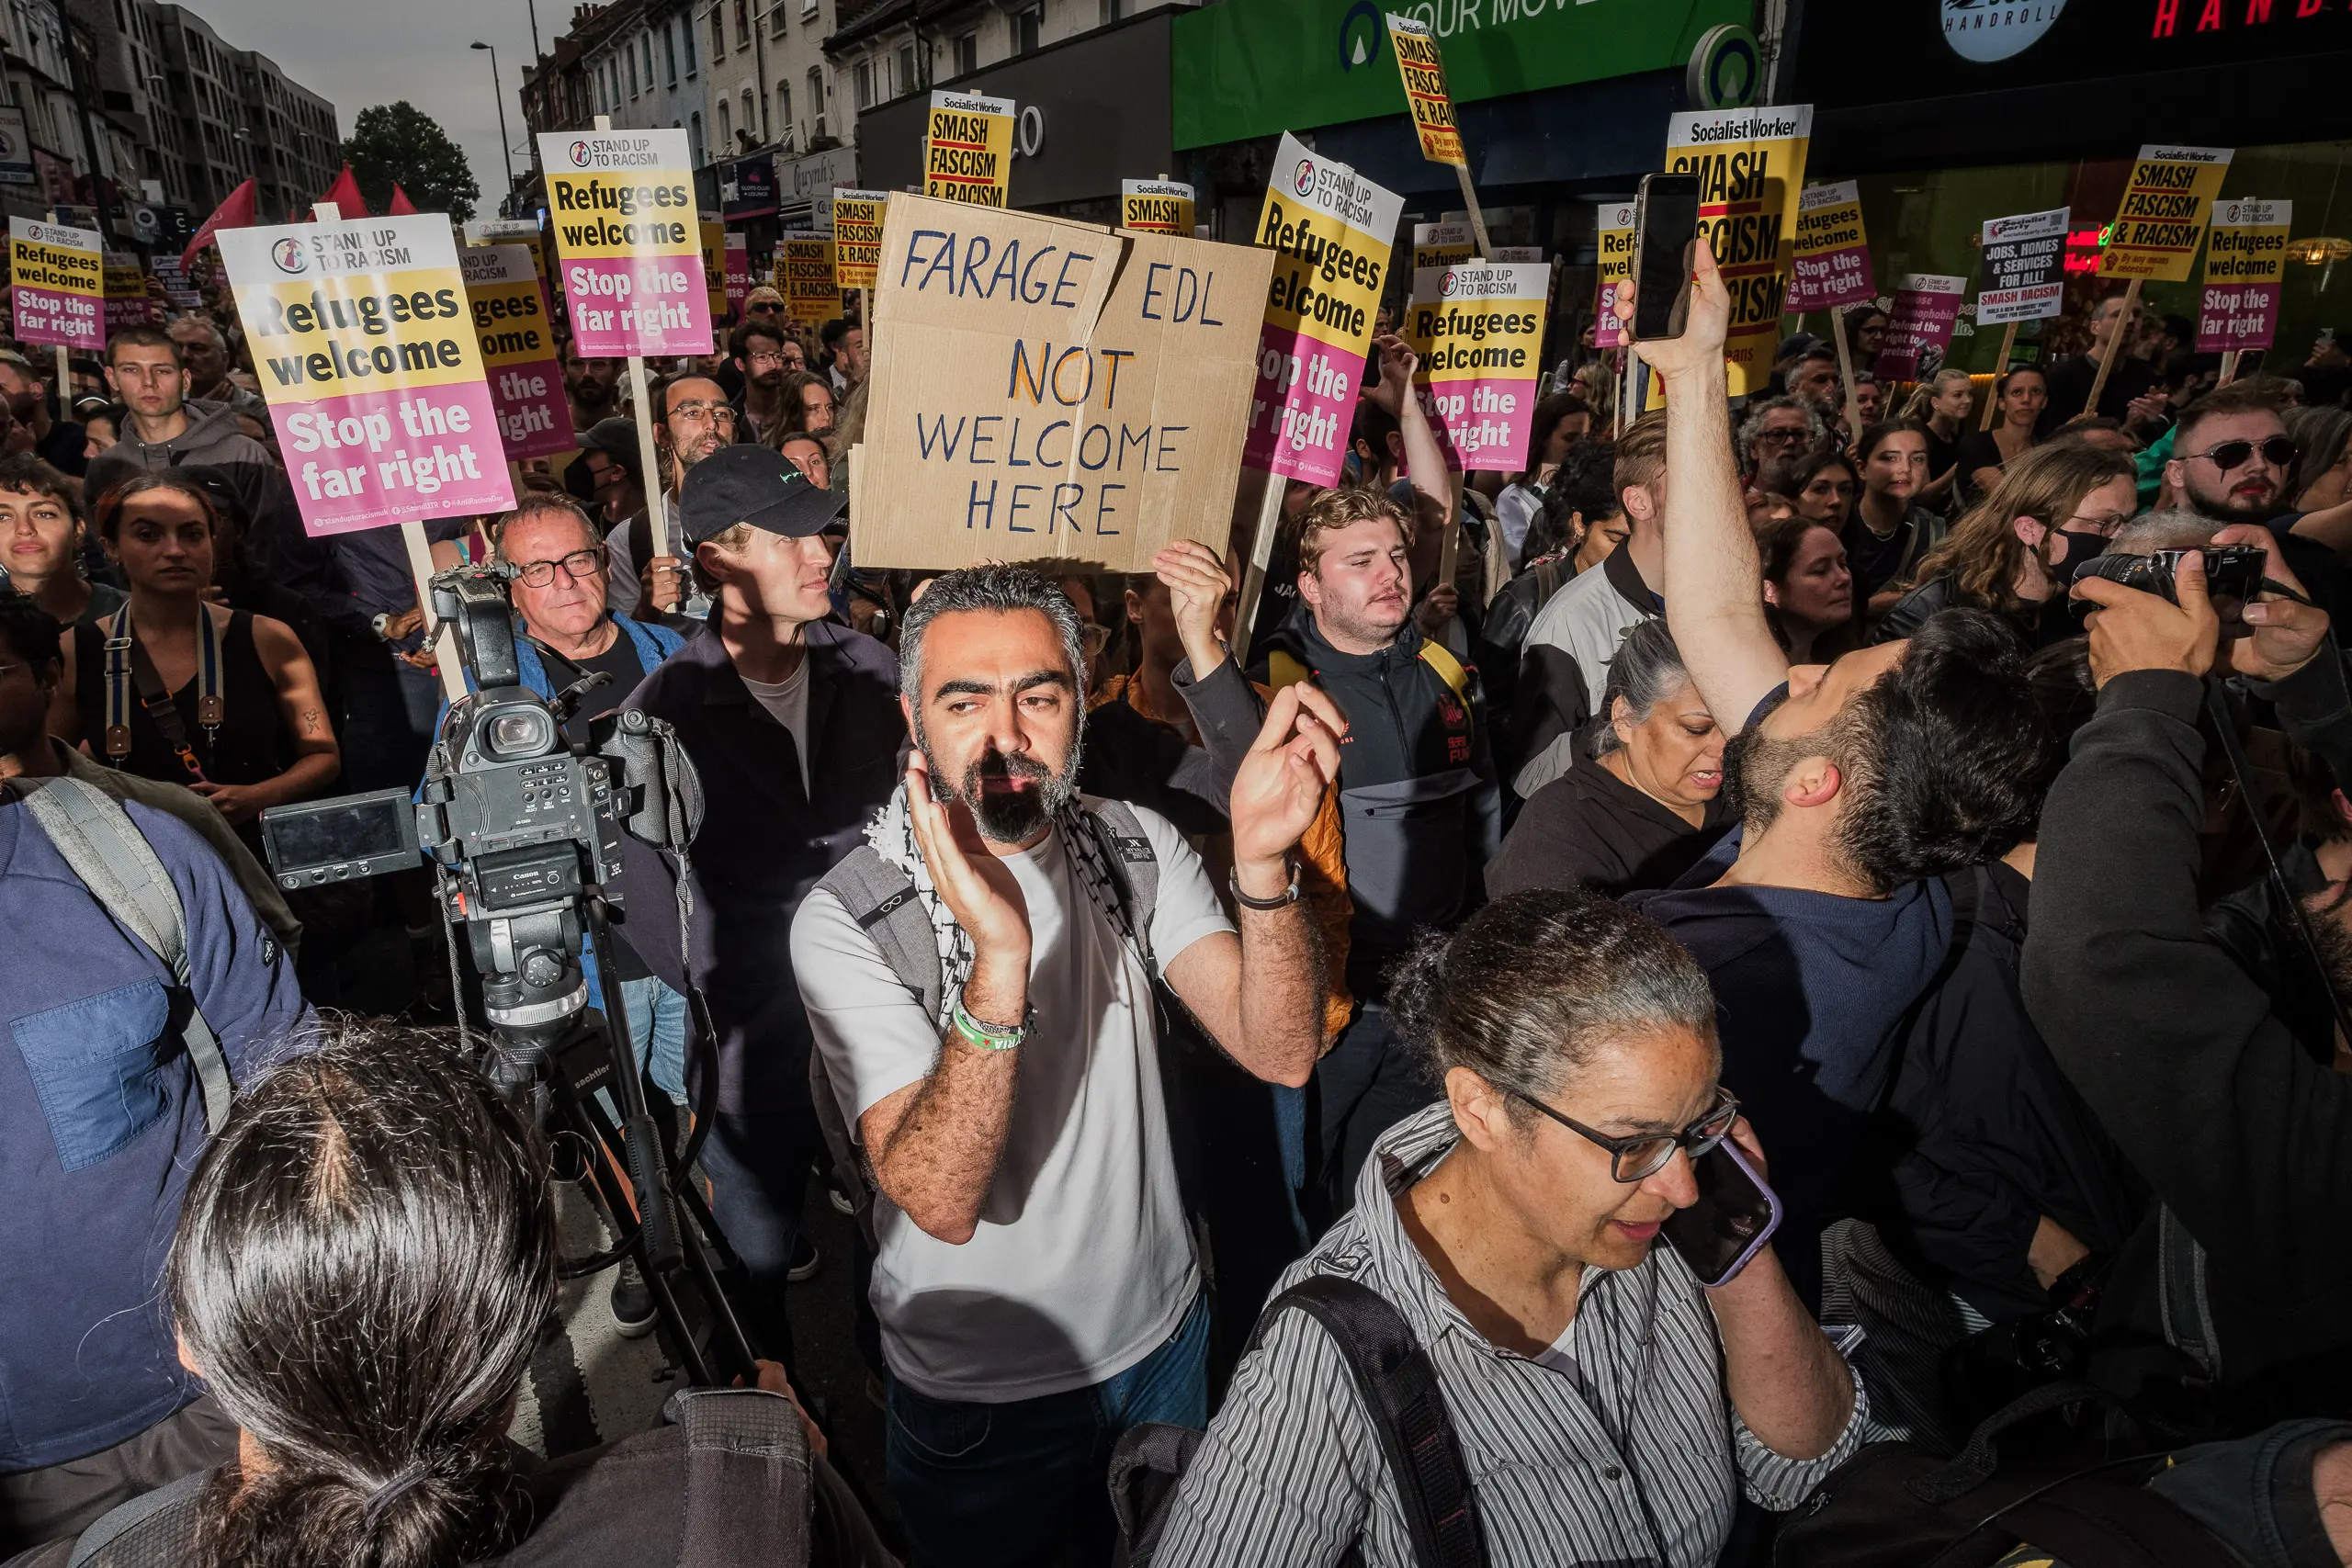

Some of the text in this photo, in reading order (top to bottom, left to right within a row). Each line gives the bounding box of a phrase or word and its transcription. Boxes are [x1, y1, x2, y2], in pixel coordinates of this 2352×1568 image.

[1943, 5, 2057, 33] HANDROLL
[1396, 35, 1438, 63] SMAS
[1404, 67, 1450, 96] FASCI
[933, 113, 989, 144] SMASH
[593, 139, 650, 154] STAND UP
[594, 152, 658, 167] TO RACISM
[931, 148, 996, 177] FASCISM
[1319, 167, 1372, 203] STAND UP
[2134, 164, 2198, 188] SMASH
[555, 180, 688, 216] Refugees
[929, 181, 1003, 209] & RACISM
[1317, 187, 1373, 228] TO RACISM
[1804, 190, 1826, 200] STAND
[1817, 196, 1842, 206] RACISM
[2123, 194, 2200, 218] FASCISM
[836, 201, 875, 220] SMASH
[1127, 198, 1180, 223] SMASH
[1797, 209, 1859, 231] efugees
[2242, 205, 2272, 213] STAND UP
[2242, 214, 2250, 222] TO
[44, 228, 68, 238] STAND
[56, 237, 84, 247] RACISM
[375, 230, 397, 248] UP
[562, 217, 686, 247] welcome
[837, 223, 884, 243] FASCISM
[1698, 213, 1781, 265] SCISM
[2113, 222, 2129, 243] &
[2132, 223, 2200, 247] RACISM
[2211, 231, 2284, 255] Refugees
[16, 243, 99, 272] Refugees
[346, 247, 412, 269] RACISM
[787, 243, 824, 258] SMASH
[838, 246, 881, 264] & RACIS
[1263, 200, 1382, 292] Refugees
[1986, 239, 2059, 260] JOBS, HOMES
[482, 254, 498, 266] UP
[788, 263, 832, 277] FASCISM
[1418, 251, 1472, 268] Refugees
[1796, 254, 1860, 277] Stop the
[1993, 263, 2001, 275] &
[2004, 254, 2052, 273] SERVICES
[2210, 256, 2277, 276] welcome
[17, 267, 96, 290] welcome
[465, 266, 508, 282] RACISM
[571, 265, 689, 302] Stop the
[900, 230, 1224, 327] FARAGE EDL
[1461, 270, 1512, 282] STAND UP
[1801, 272, 1864, 296] far right
[1999, 271, 2044, 288] FOR ALL!
[790, 283, 797, 296] &
[800, 283, 839, 297] RACISM
[1460, 283, 1517, 295] TO RACISM
[1981, 286, 2060, 306] SMASH RACISM
[2204, 288, 2268, 314] Stop the
[17, 290, 96, 316] Stop the
[254, 288, 458, 336] Refugees
[473, 295, 539, 329] gees
[1270, 270, 1365, 337] elcome
[19, 310, 96, 337] far right
[577, 301, 692, 337] far right
[1417, 308, 1536, 341] Refugees
[1924, 321, 1940, 333] the
[2201, 313, 2265, 338] far right
[1885, 333, 1919, 344] right to
[266, 338, 462, 386] welcome
[1416, 343, 1526, 373] welcome
[1882, 346, 1916, 357] protest
[1008, 339, 1136, 410] NOT
[1258, 336, 1348, 402] top the
[500, 372, 548, 401] the
[1472, 386, 1516, 414] the
[287, 398, 472, 453] Stop the
[497, 403, 554, 441] ight
[1270, 398, 1338, 452] right
[917, 412, 1190, 471] WELCOME
[1447, 419, 1510, 453] right
[302, 445, 481, 500] far right
[967, 480, 1126, 536] HERE
[513, 871, 539, 880] Canon
[994, 1032, 1023, 1049] YRIA
[574, 1064, 610, 1089] sachtler
